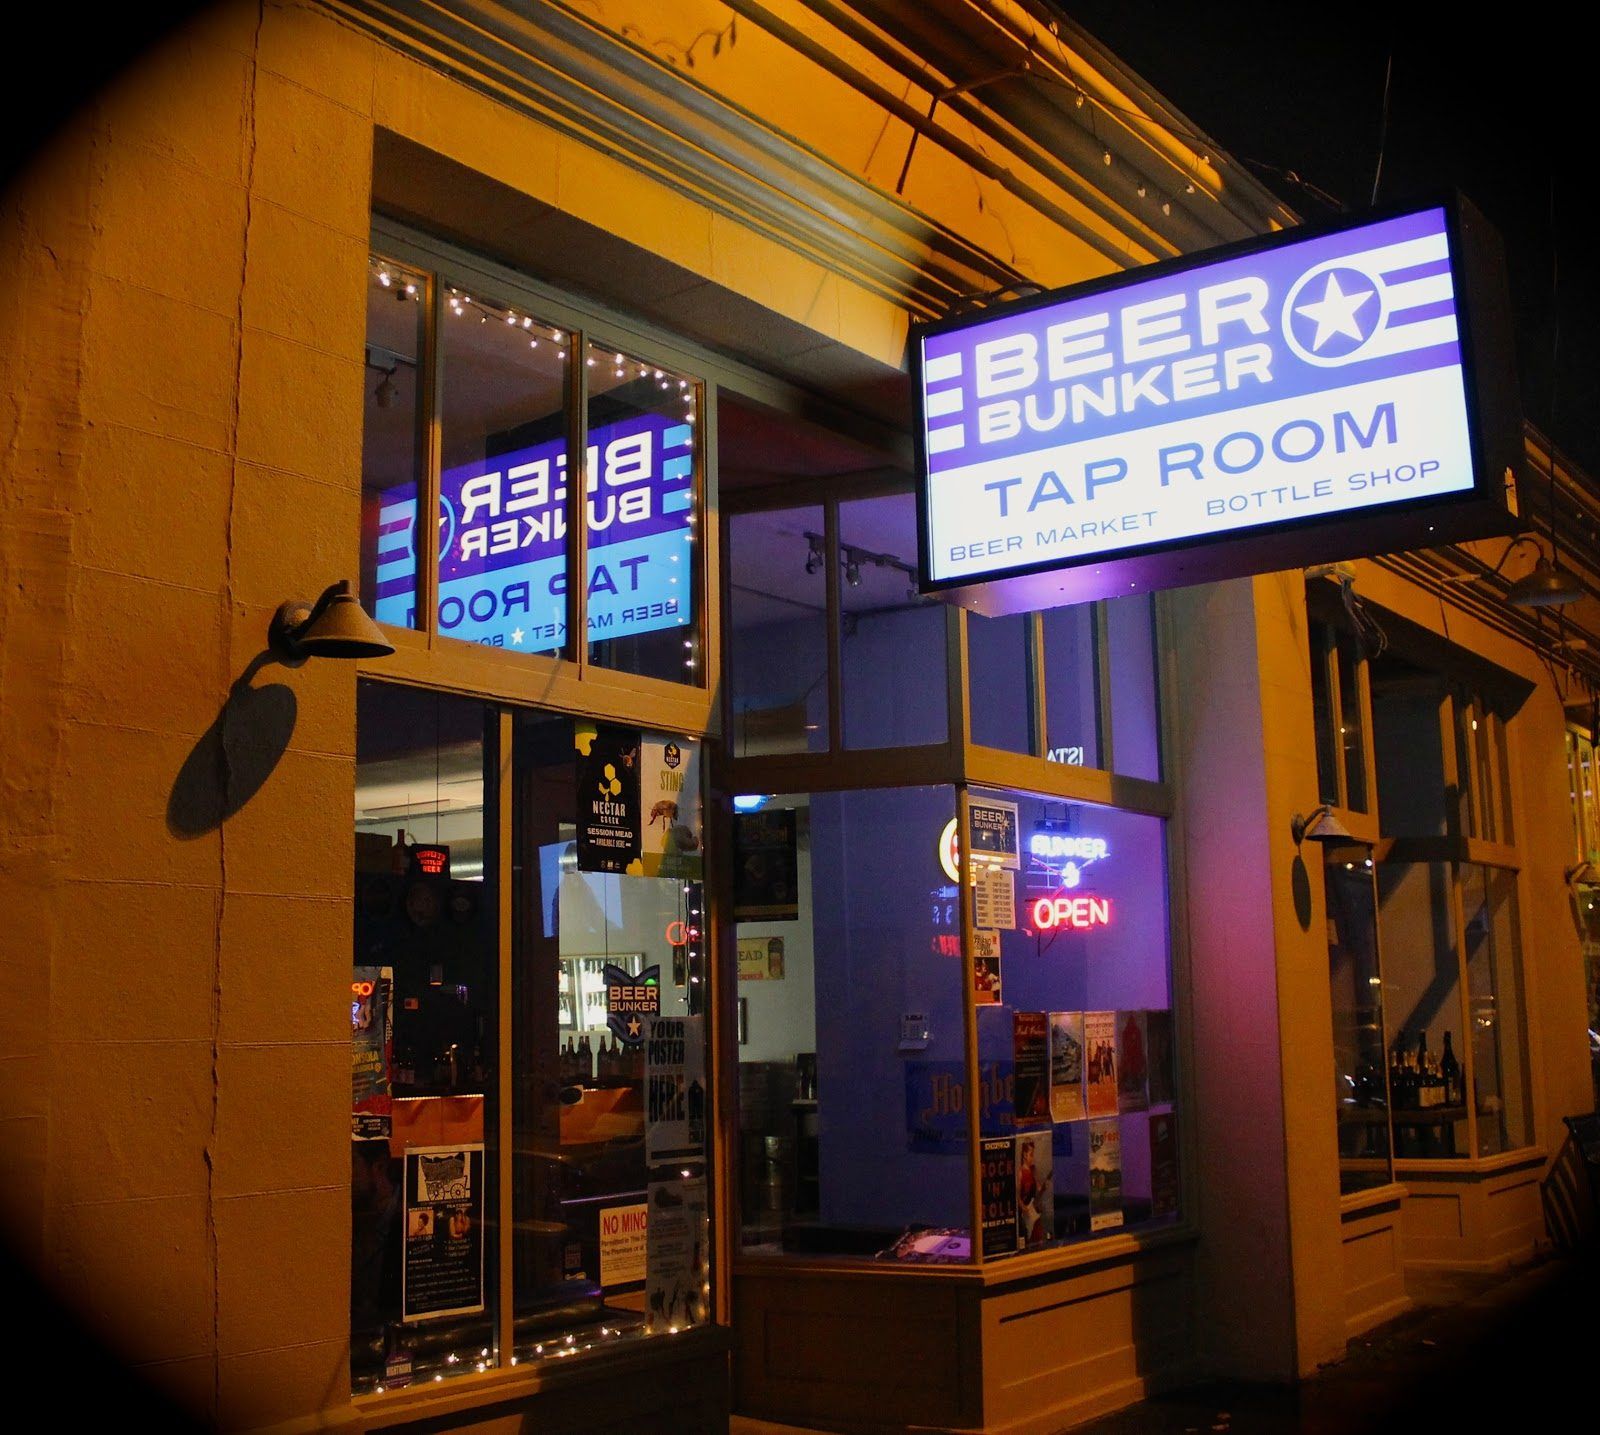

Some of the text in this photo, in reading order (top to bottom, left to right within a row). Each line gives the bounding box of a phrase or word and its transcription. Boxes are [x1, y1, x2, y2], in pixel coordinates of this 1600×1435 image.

[975, 275, 1271, 399] BEER
[977, 343, 1274, 443] BUNKER
[984, 402, 1398, 517] TAP ROOM
[950, 460, 1440, 562] BEER MARKET BOTTLE SHOP
[660, 770, 683, 792] STING
[592, 800, 626, 817] NECTAR
[974, 809, 1004, 823] BEER
[587, 827, 633, 839] SESSION MEAD
[974, 820, 1003, 831] BUNKER
[1034, 898, 1109, 928] OPEN
[609, 986, 657, 1000] BEER
[609, 1001, 658, 1011] BUNKER
[649, 1021, 684, 1039] YOUR
[649, 1039, 685, 1065] POSTER
[604, 1216, 618, 1235] NO
